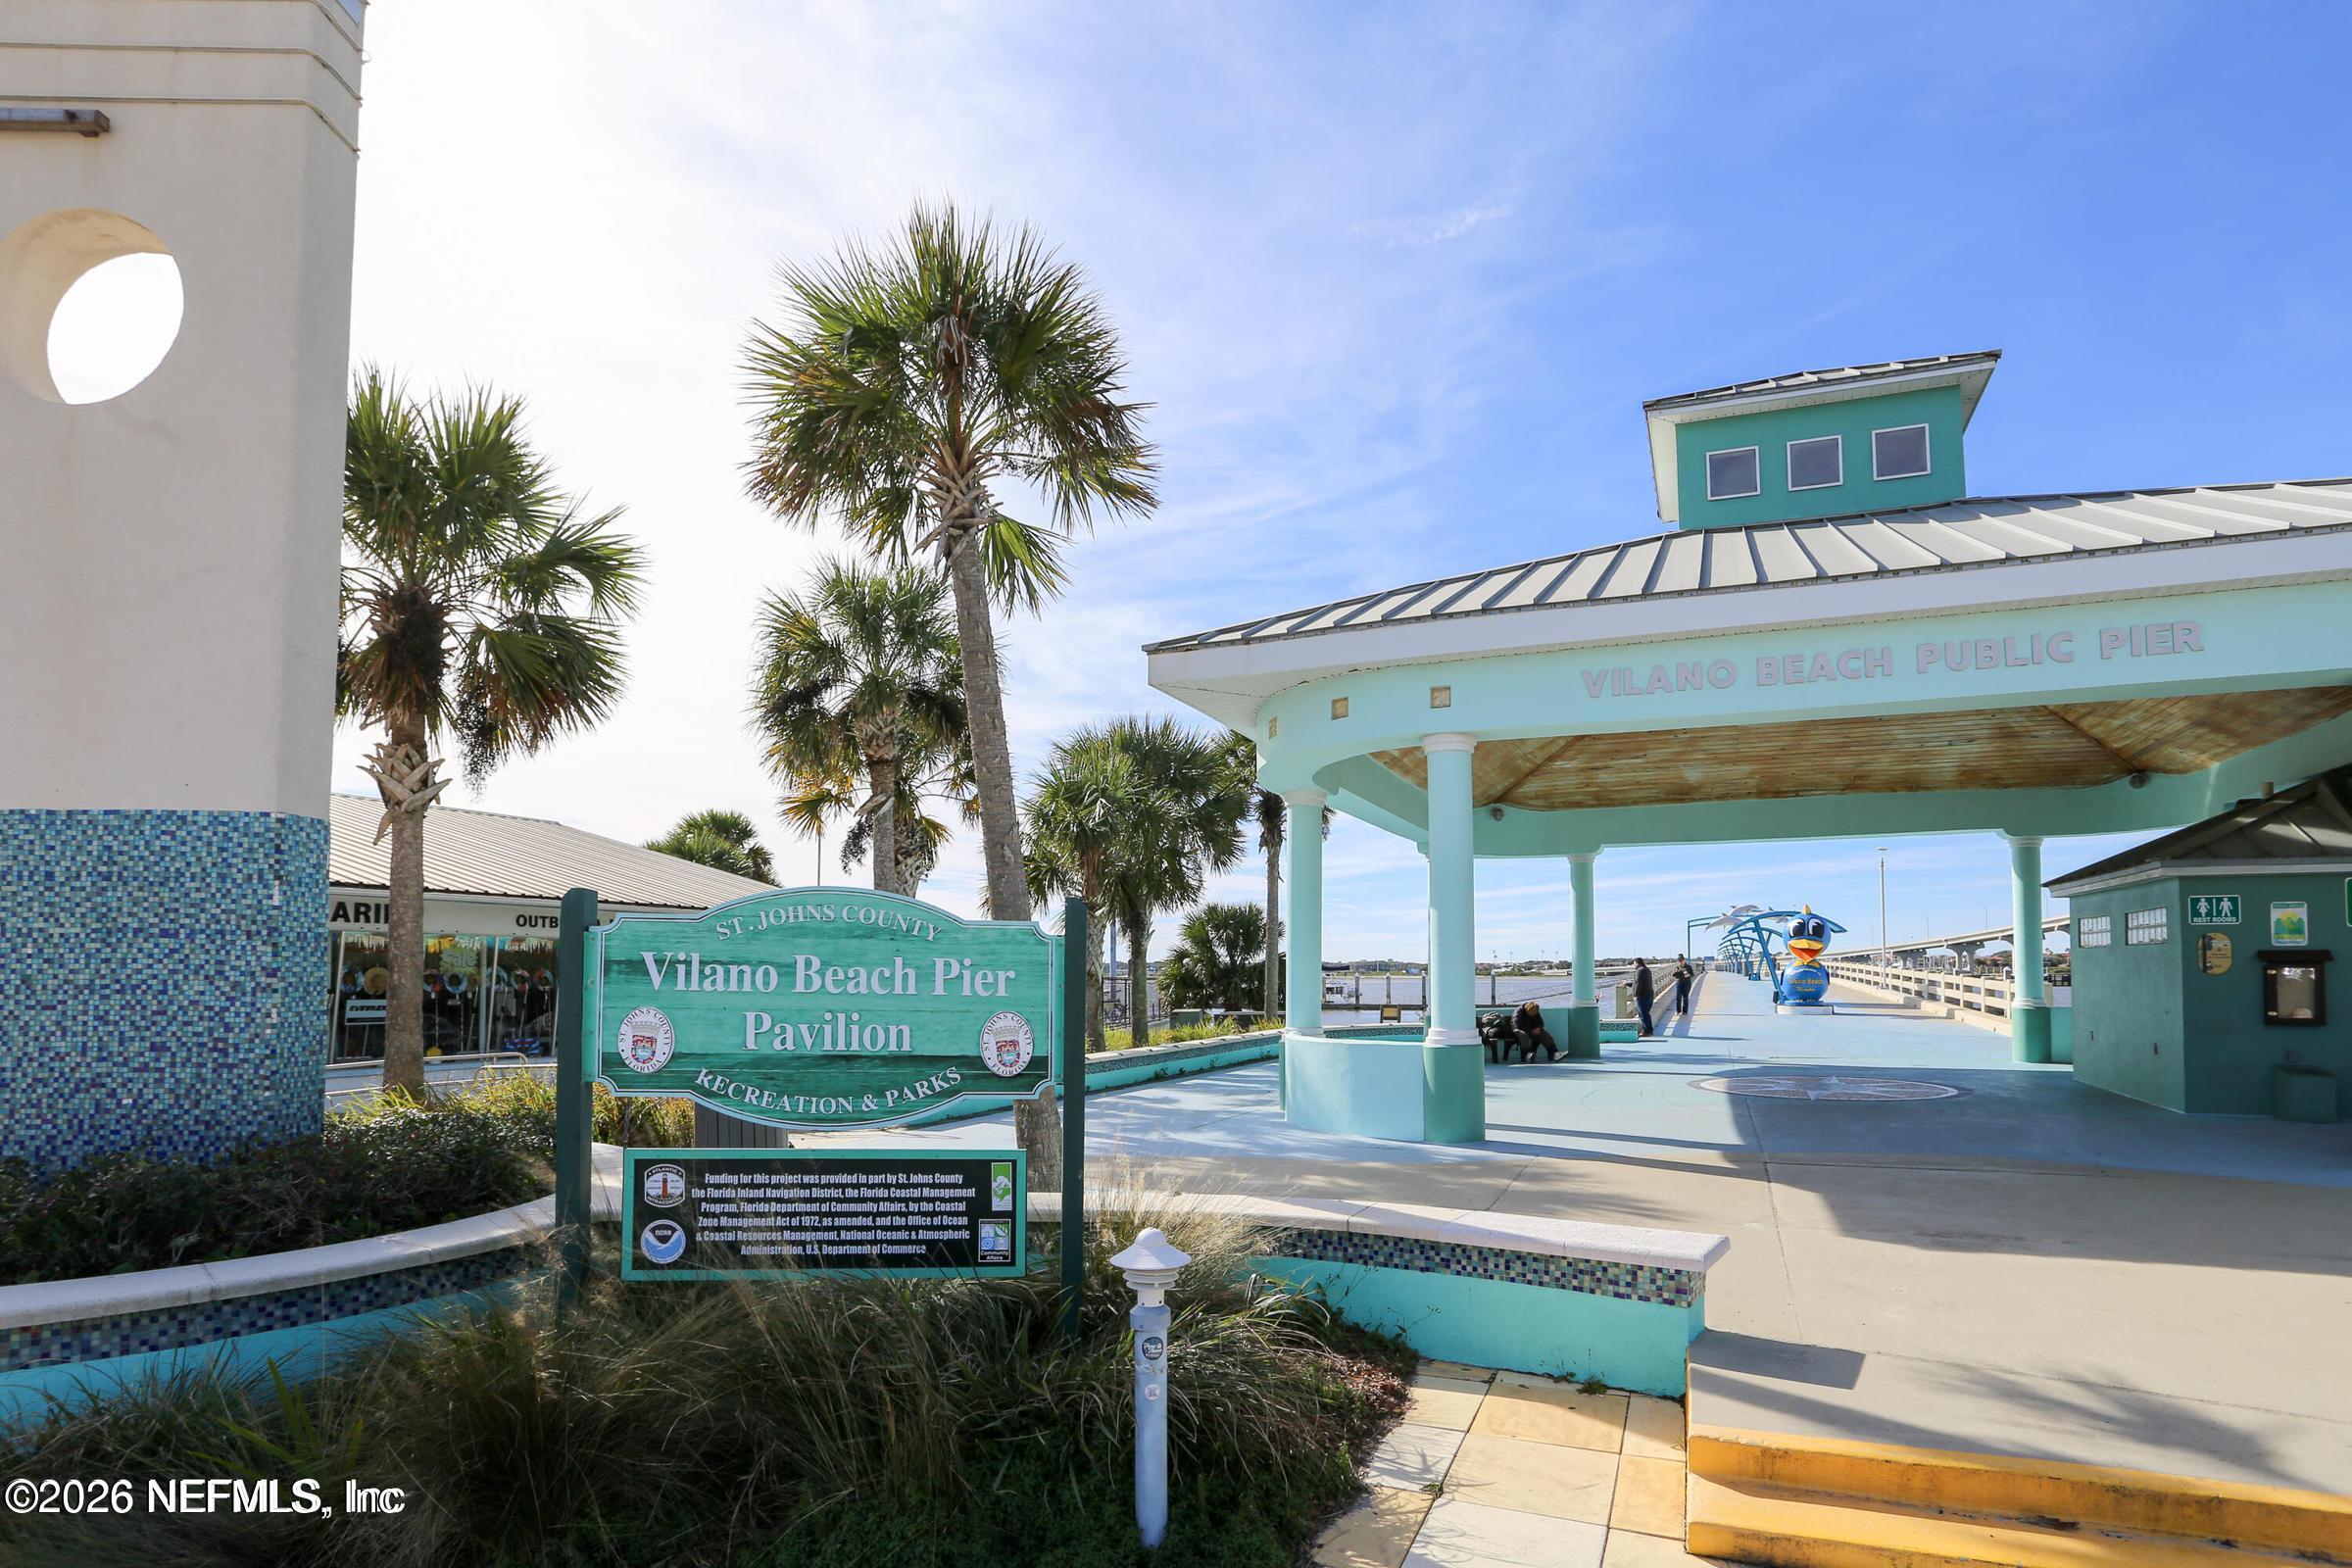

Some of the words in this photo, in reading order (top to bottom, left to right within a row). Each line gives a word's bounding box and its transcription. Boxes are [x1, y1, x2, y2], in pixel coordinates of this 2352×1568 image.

[1581, 659, 1738, 700] VILANO
[1755, 647, 1893, 687] BEACH
[1916, 631, 2075, 674] PUBLIC
[2099, 620, 2205, 660] PIER
[758, 904, 835, 931] JOHNS
[842, 905, 942, 942] COUNTY
[640, 951, 778, 993] Vilano
[791, 955, 918, 995] Beach
[931, 957, 1016, 997] Pier
[742, 1011, 913, 1052] Pavilion
[694, 1066, 854, 1115] RECREATION
[861, 1094, 879, 1111] &
[884, 1066, 961, 1108] PARKS
[652, 1166, 678, 1175] ATLANTIC
[705, 1173, 739, 1185] Funding
[740, 1173, 753, 1184] for
[754, 1173, 769, 1184] this
[770, 1173, 802, 1185] project
[803, 1175, 819, 1184] was
[820, 1173, 858, 1185] provided
[858, 1173, 867, 1184] in
[868, 1174, 885, 1185] part
[887, 1173, 897, 1185] by
[898, 1173, 908, 1184] St.
[909, 1173, 933, 1184] Johns
[934, 1173, 963, 1185] County
[691, 1188, 706, 1198] the
[707, 1188, 736, 1198] Florida
[737, 1188, 764, 1198] Inland
[765, 1188, 810, 1199] Navigation
[811, 1188, 844, 1199] District,
[845, 1188, 859, 1198] the
[860, 1188, 889, 1198] Florida
[890, 1188, 921, 1198] Coastal
[922, 1188, 976, 1199] Management
[701, 1201, 739, 1213] Program,
[740, 1201, 769, 1212] Florida
[770, 1201, 820, 1213] Department
[820, 1201, 830, 1212] of
[831, 1201, 878, 1213] Community
[879, 1201, 908, 1212] Affairs,
[908, 1201, 918, 1212] by
[919, 1201, 934, 1211] the
[935, 1201, 966, 1211] Coastal
[698, 1216, 718, 1227] Zone
[719, 1216, 775, 1227] Management
[775, 1216, 790, 1227] Act
[791, 1216, 801, 1227] of
[802, 1216, 821, 1227] 1972,
[834, 1216, 874, 1227] amended,
[875, 1216, 892, 1226] and
[893, 1216, 906, 1226] the
[907, 1215, 932, 1226] Office
[932, 1215, 942, 1226] of
[942, 1216, 968, 1226] Ocean
[696, 1233, 703, 1242] &
[704, 1231, 735, 1241] Coastal
[737, 1231, 782, 1241] Resources
[783, 1231, 839, 1242] Management,
[840, 1230, 875, 1241] National
[876, 1230, 909, 1240] Oceanic
[910, 1231, 917, 1240] &
[918, 1229, 970, 1241] Atmospheric
[741, 1245, 805, 1255] Administration,
[806, 1245, 820, 1254] U.S.
[821, 1245, 870, 1255] Department
[872, 1245, 881, 1254] of
[882, 1245, 926, 1254] Commerce
